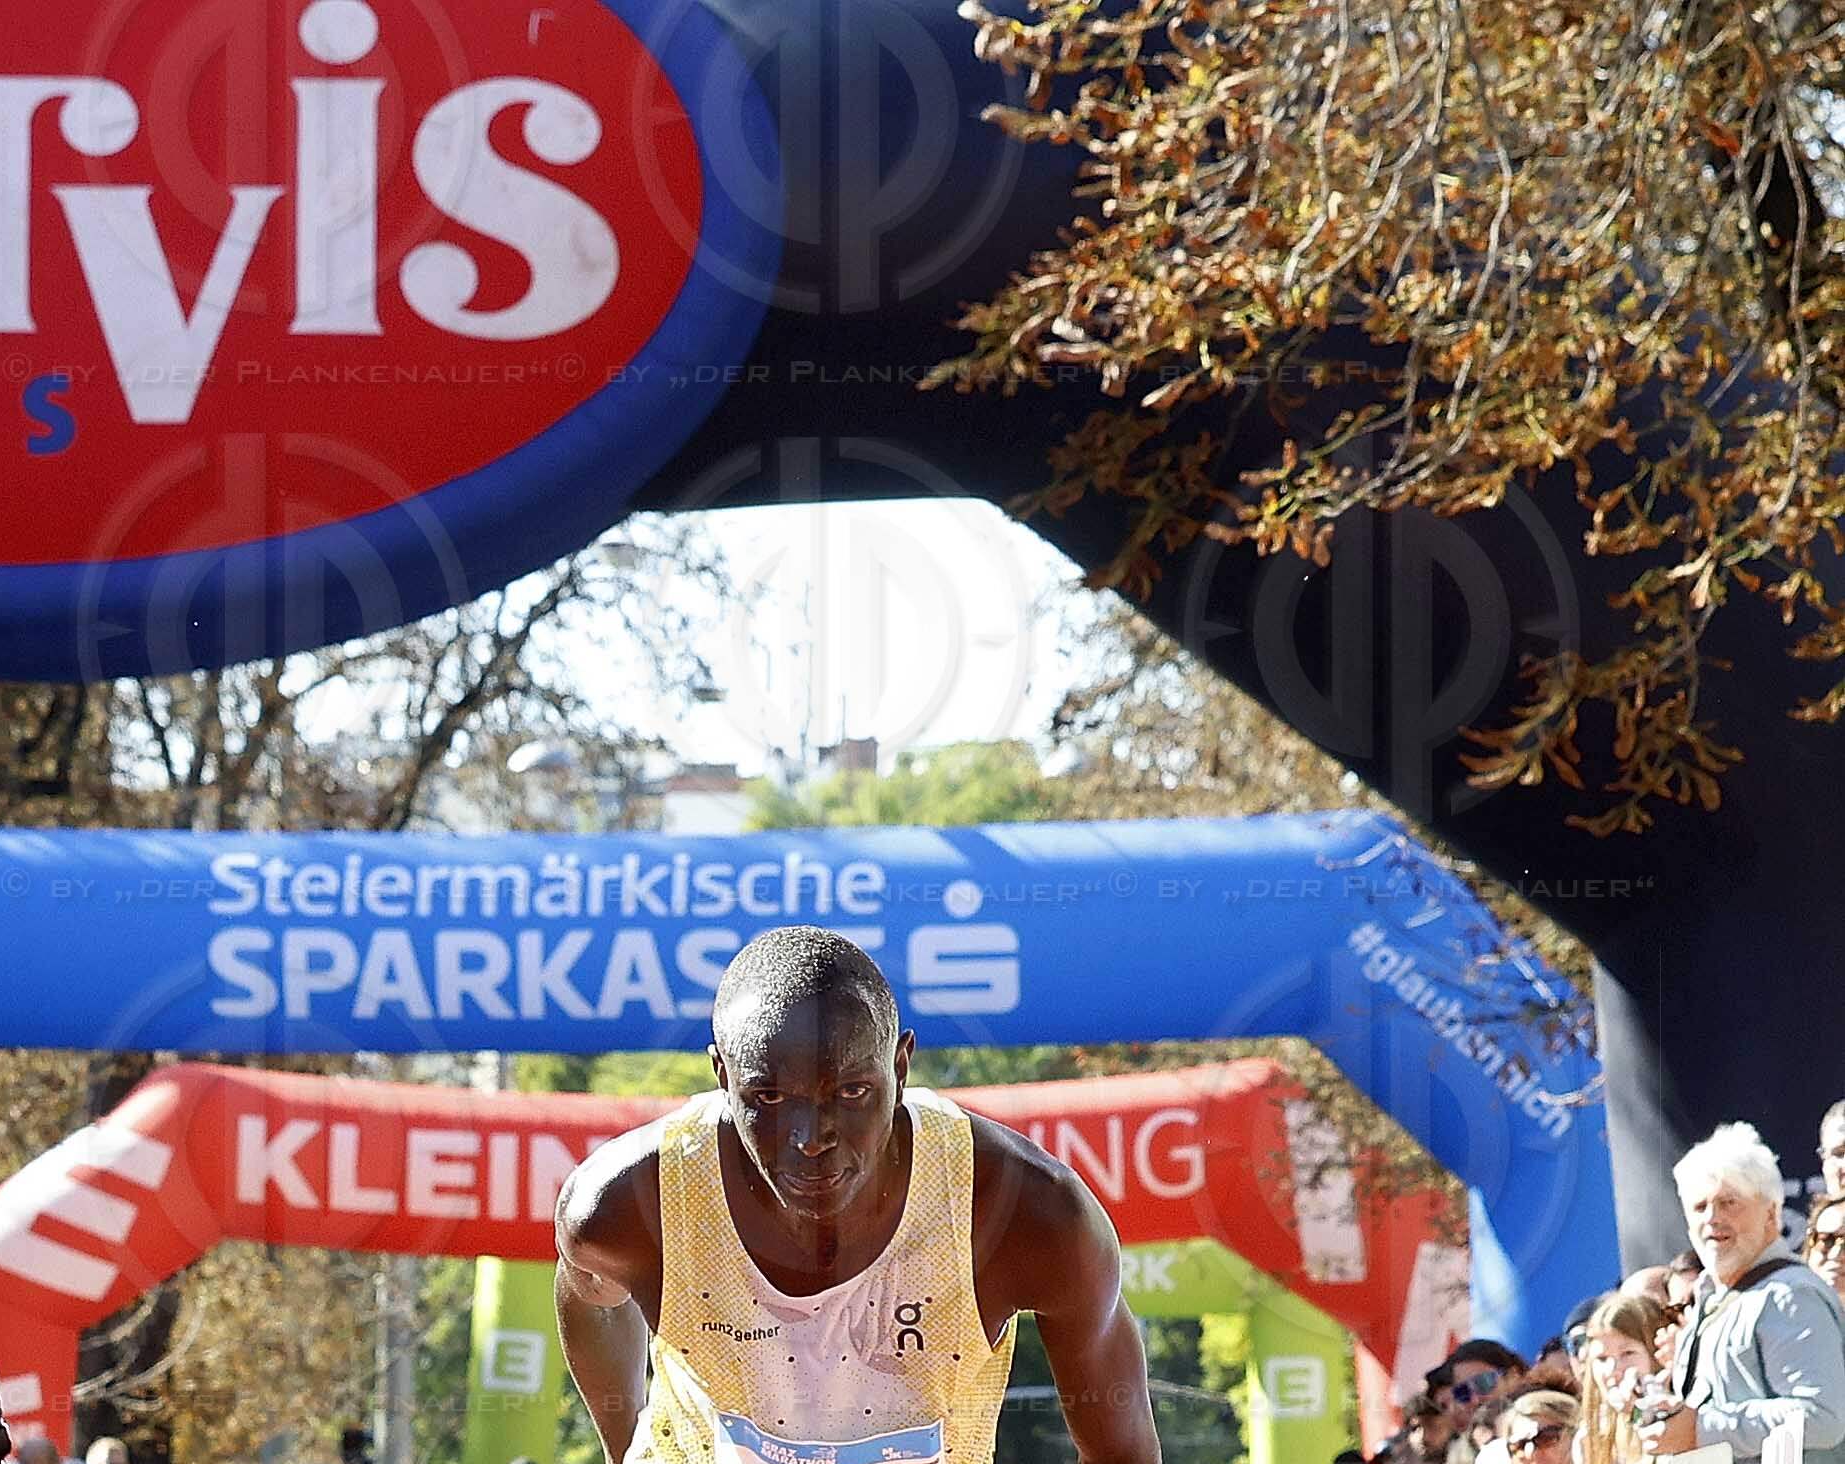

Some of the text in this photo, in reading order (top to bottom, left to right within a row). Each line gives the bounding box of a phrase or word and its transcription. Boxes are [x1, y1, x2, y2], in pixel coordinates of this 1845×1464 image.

[207, 852, 887, 919] Steiermärkische
[206, 925, 887, 1021] SPARKAS
[235, 1113, 610, 1223] KLEIN
[701, 1321, 781, 1342] run2gether
[760, 1440, 797, 1458] GRAZ
